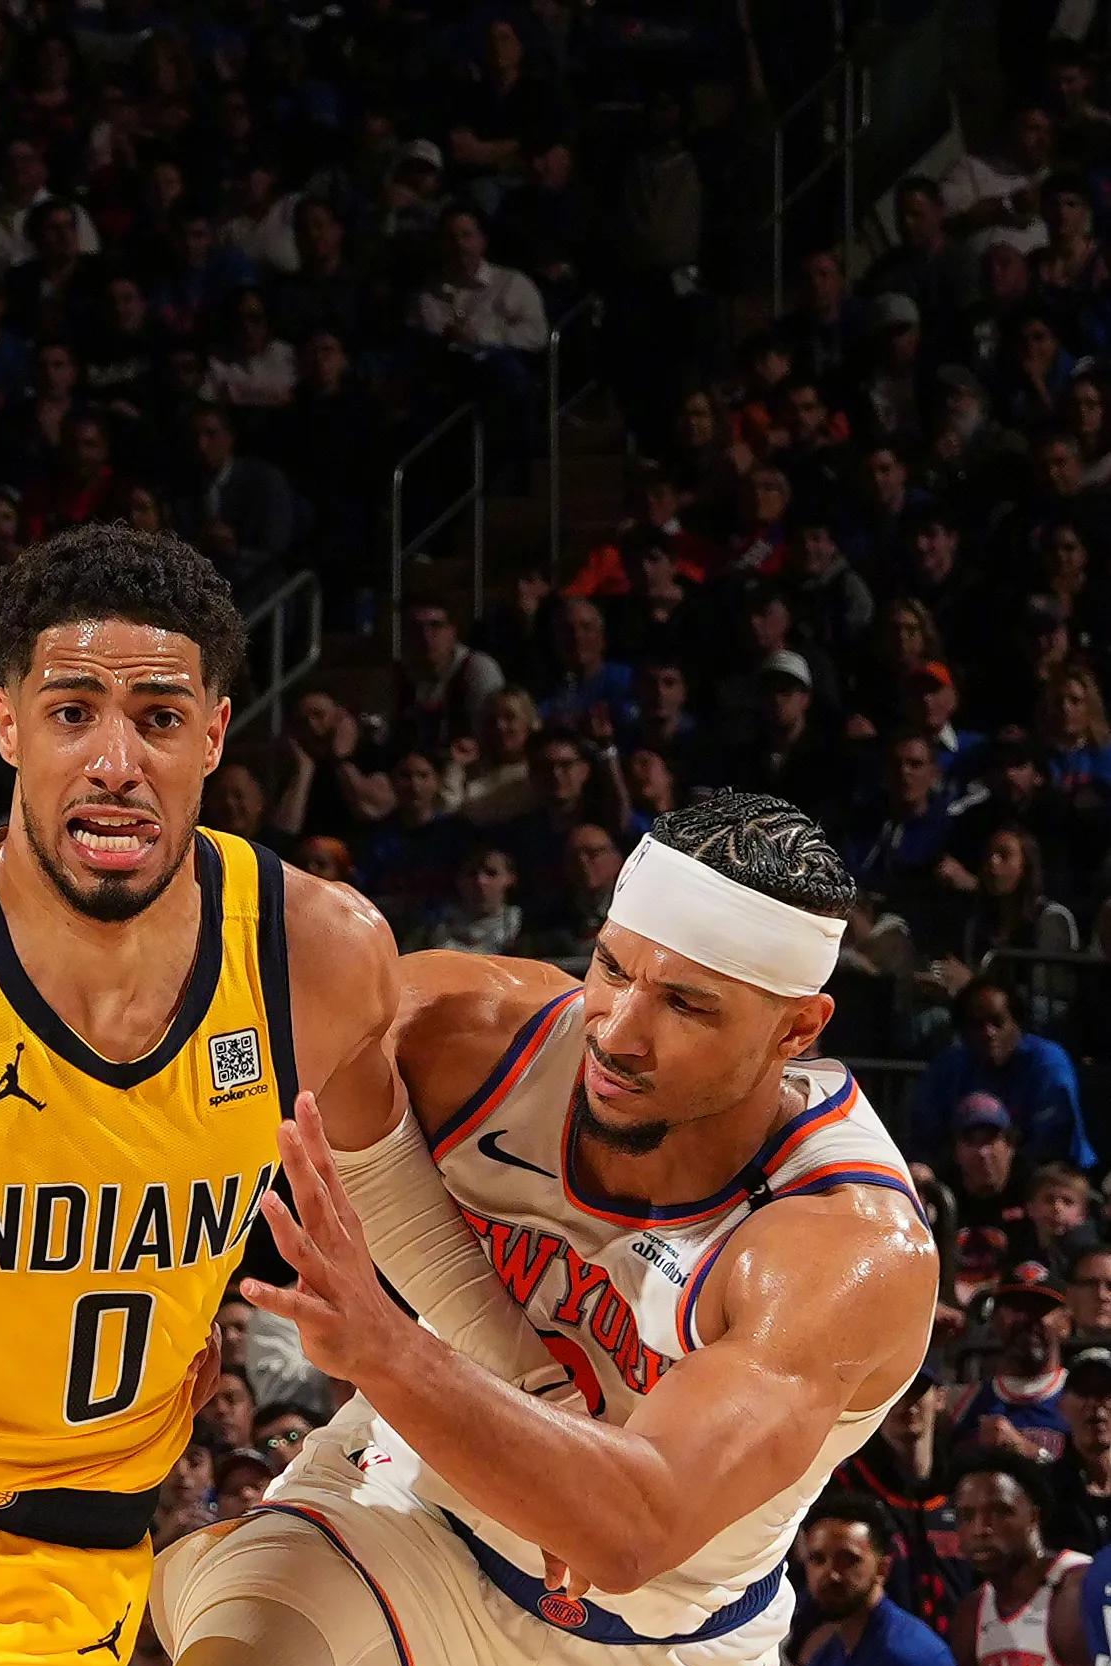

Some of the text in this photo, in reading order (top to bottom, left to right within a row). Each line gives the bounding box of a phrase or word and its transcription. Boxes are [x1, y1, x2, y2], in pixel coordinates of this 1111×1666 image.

[209, 1084, 268, 1107] spokenote
[632, 1241, 692, 1288] abu dhbi
[62, 1290, 157, 1427] 0
